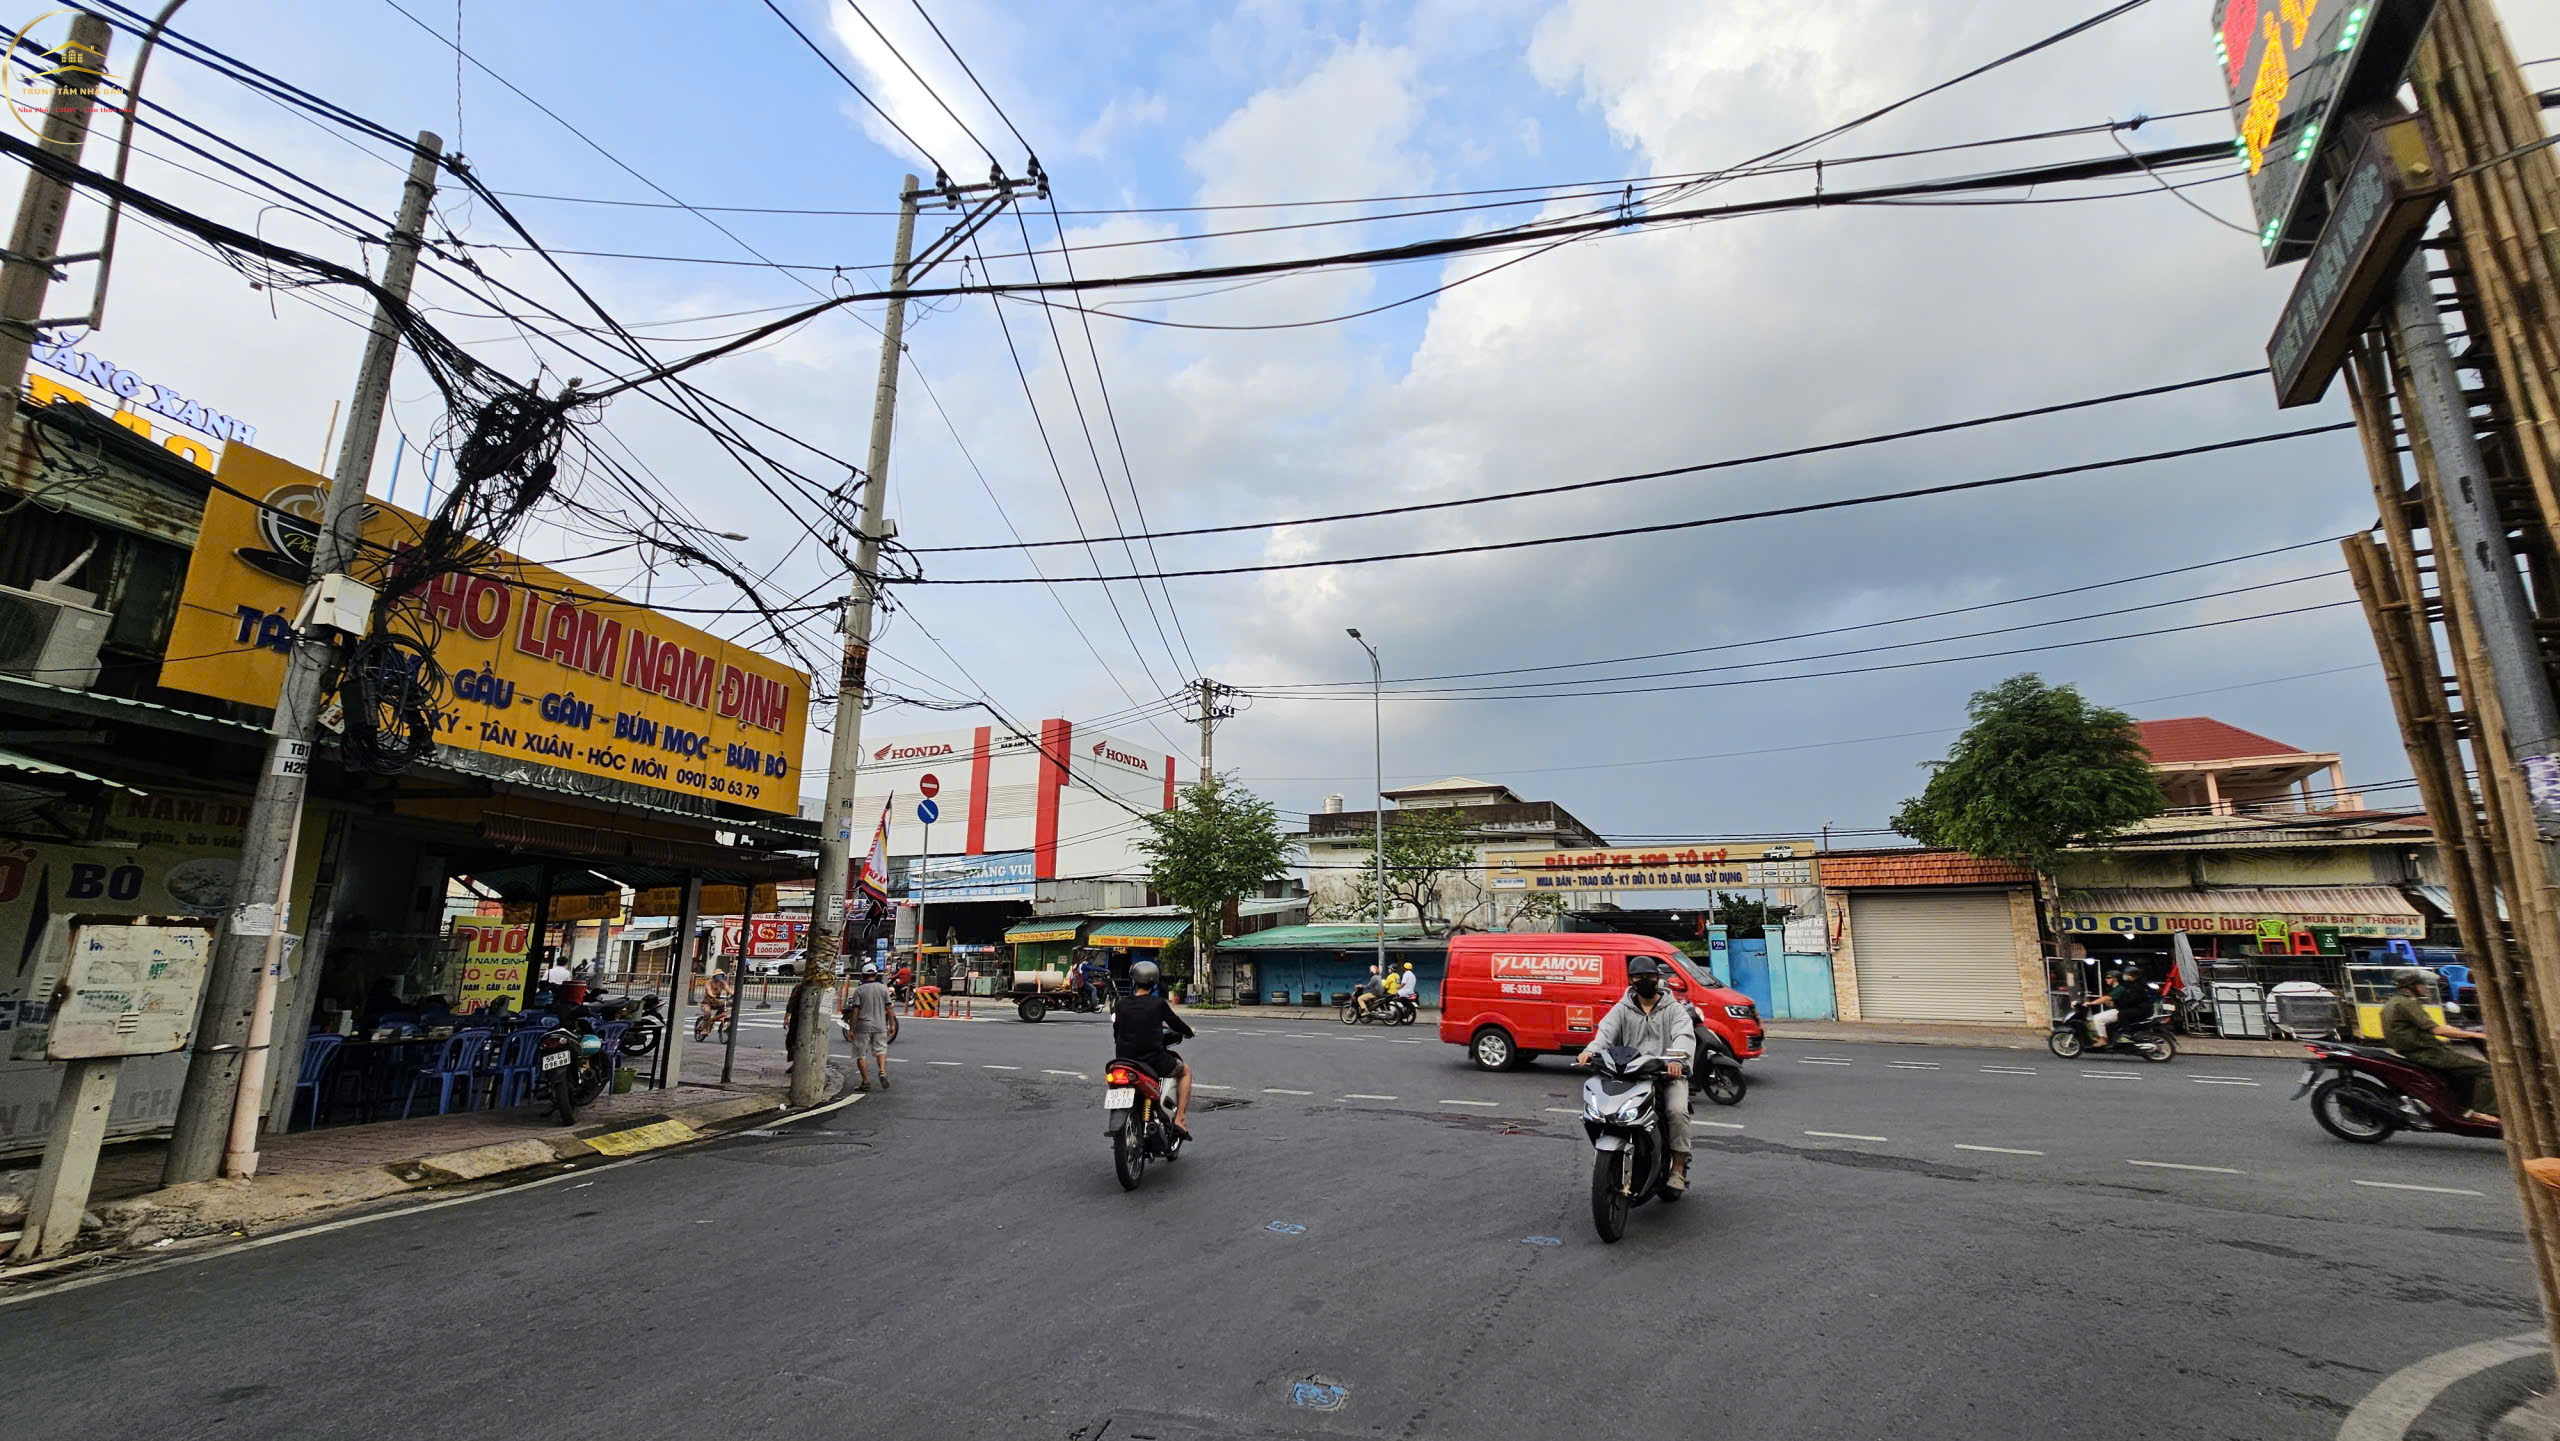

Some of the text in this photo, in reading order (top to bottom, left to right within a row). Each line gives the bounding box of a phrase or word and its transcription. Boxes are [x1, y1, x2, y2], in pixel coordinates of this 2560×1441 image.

[147, 384, 257, 444] XANH
[515, 587, 623, 681] LÂM
[622, 626, 718, 711] NAM
[715, 662, 790, 734] ĐỊNH
[454, 660, 515, 710] GẦU
[540, 691, 593, 730] GÂN
[613, 711, 658, 748] BÚN
[661, 729, 710, 761] MỌC
[726, 741, 760, 773] BÚN
[764, 751, 788, 779] BÒ
[480, 720, 517, 748] TÂN
[522, 732, 574, 760] XUÂN
[587, 747, 626, 772] HÓC
[631, 756, 668, 781] MÔN
[676, 768, 706, 791] 0901
[709, 778, 727, 793] 30
[728, 781, 744, 796] 63
[745, 785, 760, 800] 79
[891, 744, 953, 759] HONDA
[1105, 748, 1149, 770] HONDA
[1675, 848, 1699, 868] TÔ
[1702, 847, 1729, 867] KÝ
[66, 855, 144, 900] BÒ
[1009, 864, 1031, 876] VUI
[1536, 876, 1553, 887] MUA
[1556, 874, 1572, 887] BÁN
[1578, 875, 1598, 886] TRAO
[1619, 873, 1630, 885] KÝ
[1657, 871, 1668, 885] TÔ
[1684, 872, 1702, 885] QUA
[1705, 869, 1717, 884] SỬ
[1719, 871, 1743, 885] DỤNG
[2302, 915, 2327, 924] MUA
[455, 923, 528, 954] PHỞ
[493, 966, 519, 981] GÀ
[1510, 956, 1600, 972] LALAMOVE
